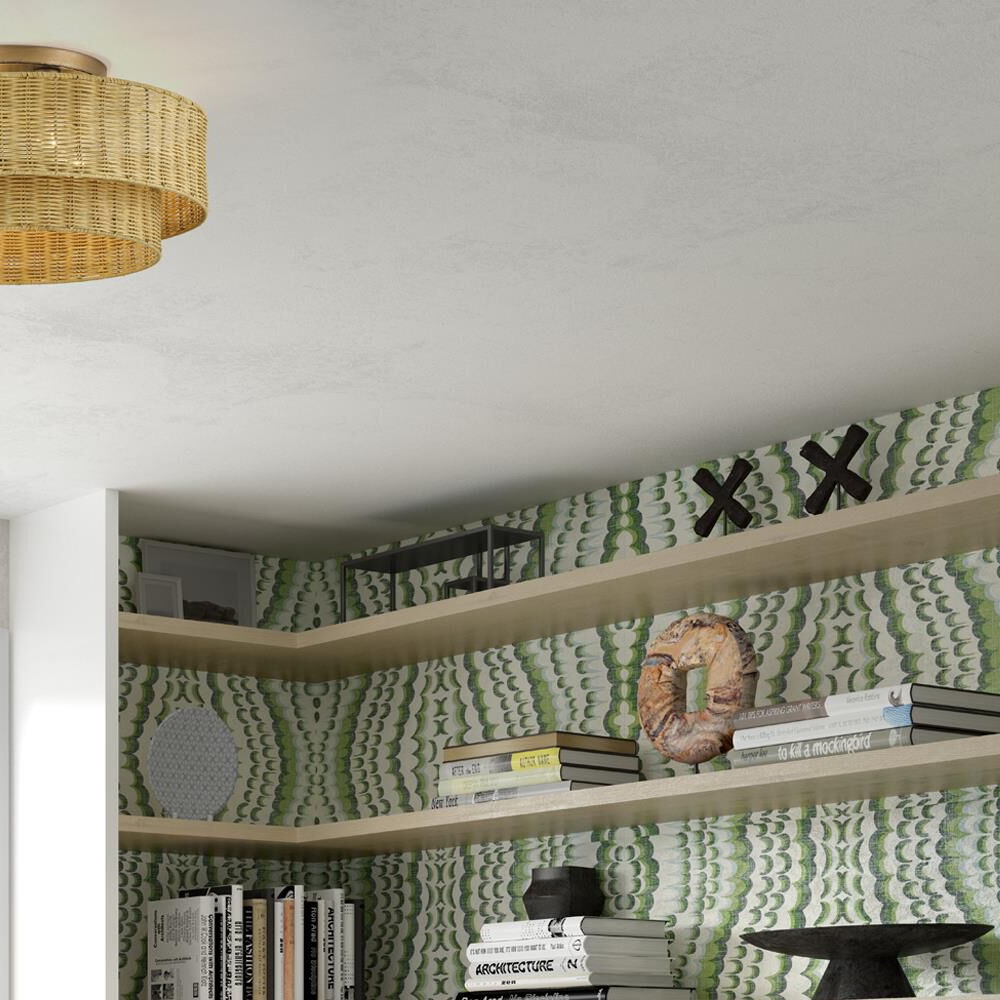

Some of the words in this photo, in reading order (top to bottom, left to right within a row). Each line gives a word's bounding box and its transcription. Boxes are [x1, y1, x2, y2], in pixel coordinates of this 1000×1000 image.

[777, 746, 787, 761] to
[790, 743, 802, 759] kill
[804, 748, 811, 758] a
[812, 732, 872, 755] mockingbird
[431, 797, 443, 810] New
[245, 910, 254, 932] THE
[245, 934, 254, 984] FASHION
[476, 959, 554, 975] ARCHITECTURE
